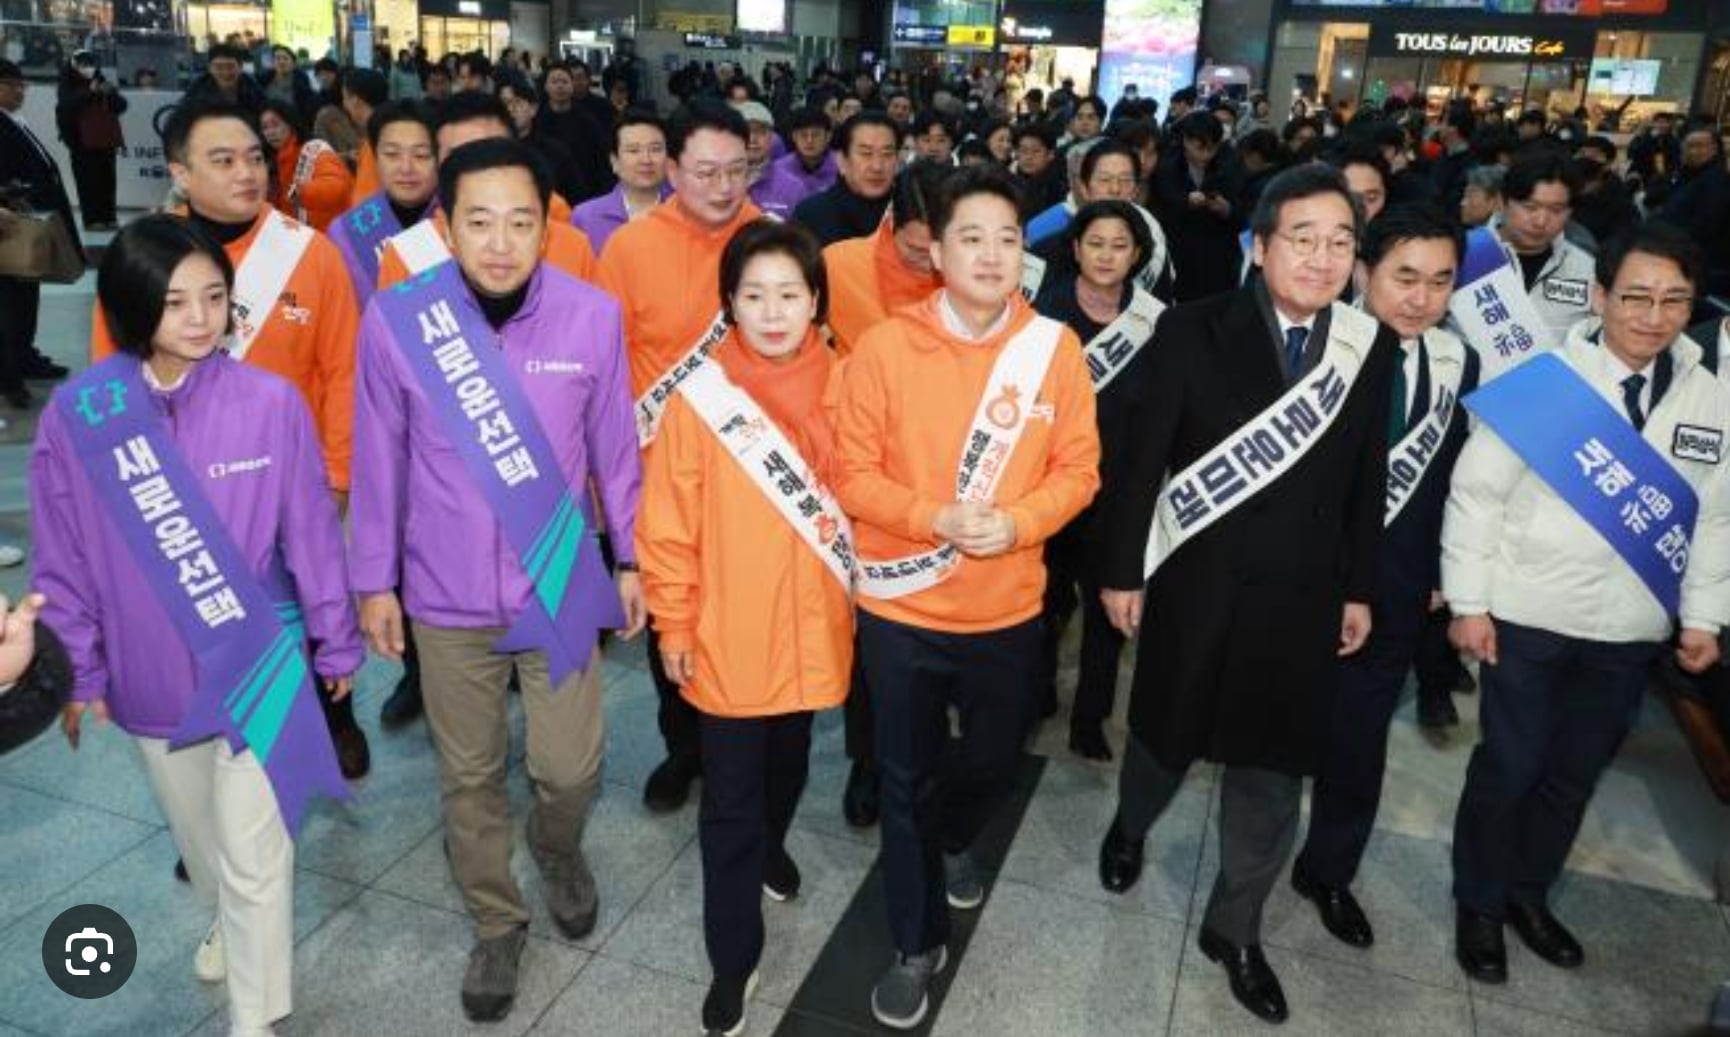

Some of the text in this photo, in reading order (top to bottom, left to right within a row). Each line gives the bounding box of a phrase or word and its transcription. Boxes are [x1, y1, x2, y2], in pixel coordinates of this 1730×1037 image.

[1394, 33, 1448, 51] TOUS
[1467, 35, 1533, 56] JOURS
[1474, 281, 1511, 326] 새해
[417, 299, 540, 488] 새로운선택
[762, 450, 807, 496] 새해
[1168, 365, 1346, 531] 새로운미래
[1573, 437, 1636, 497] 새해
[112, 434, 247, 628] 새로운선택
